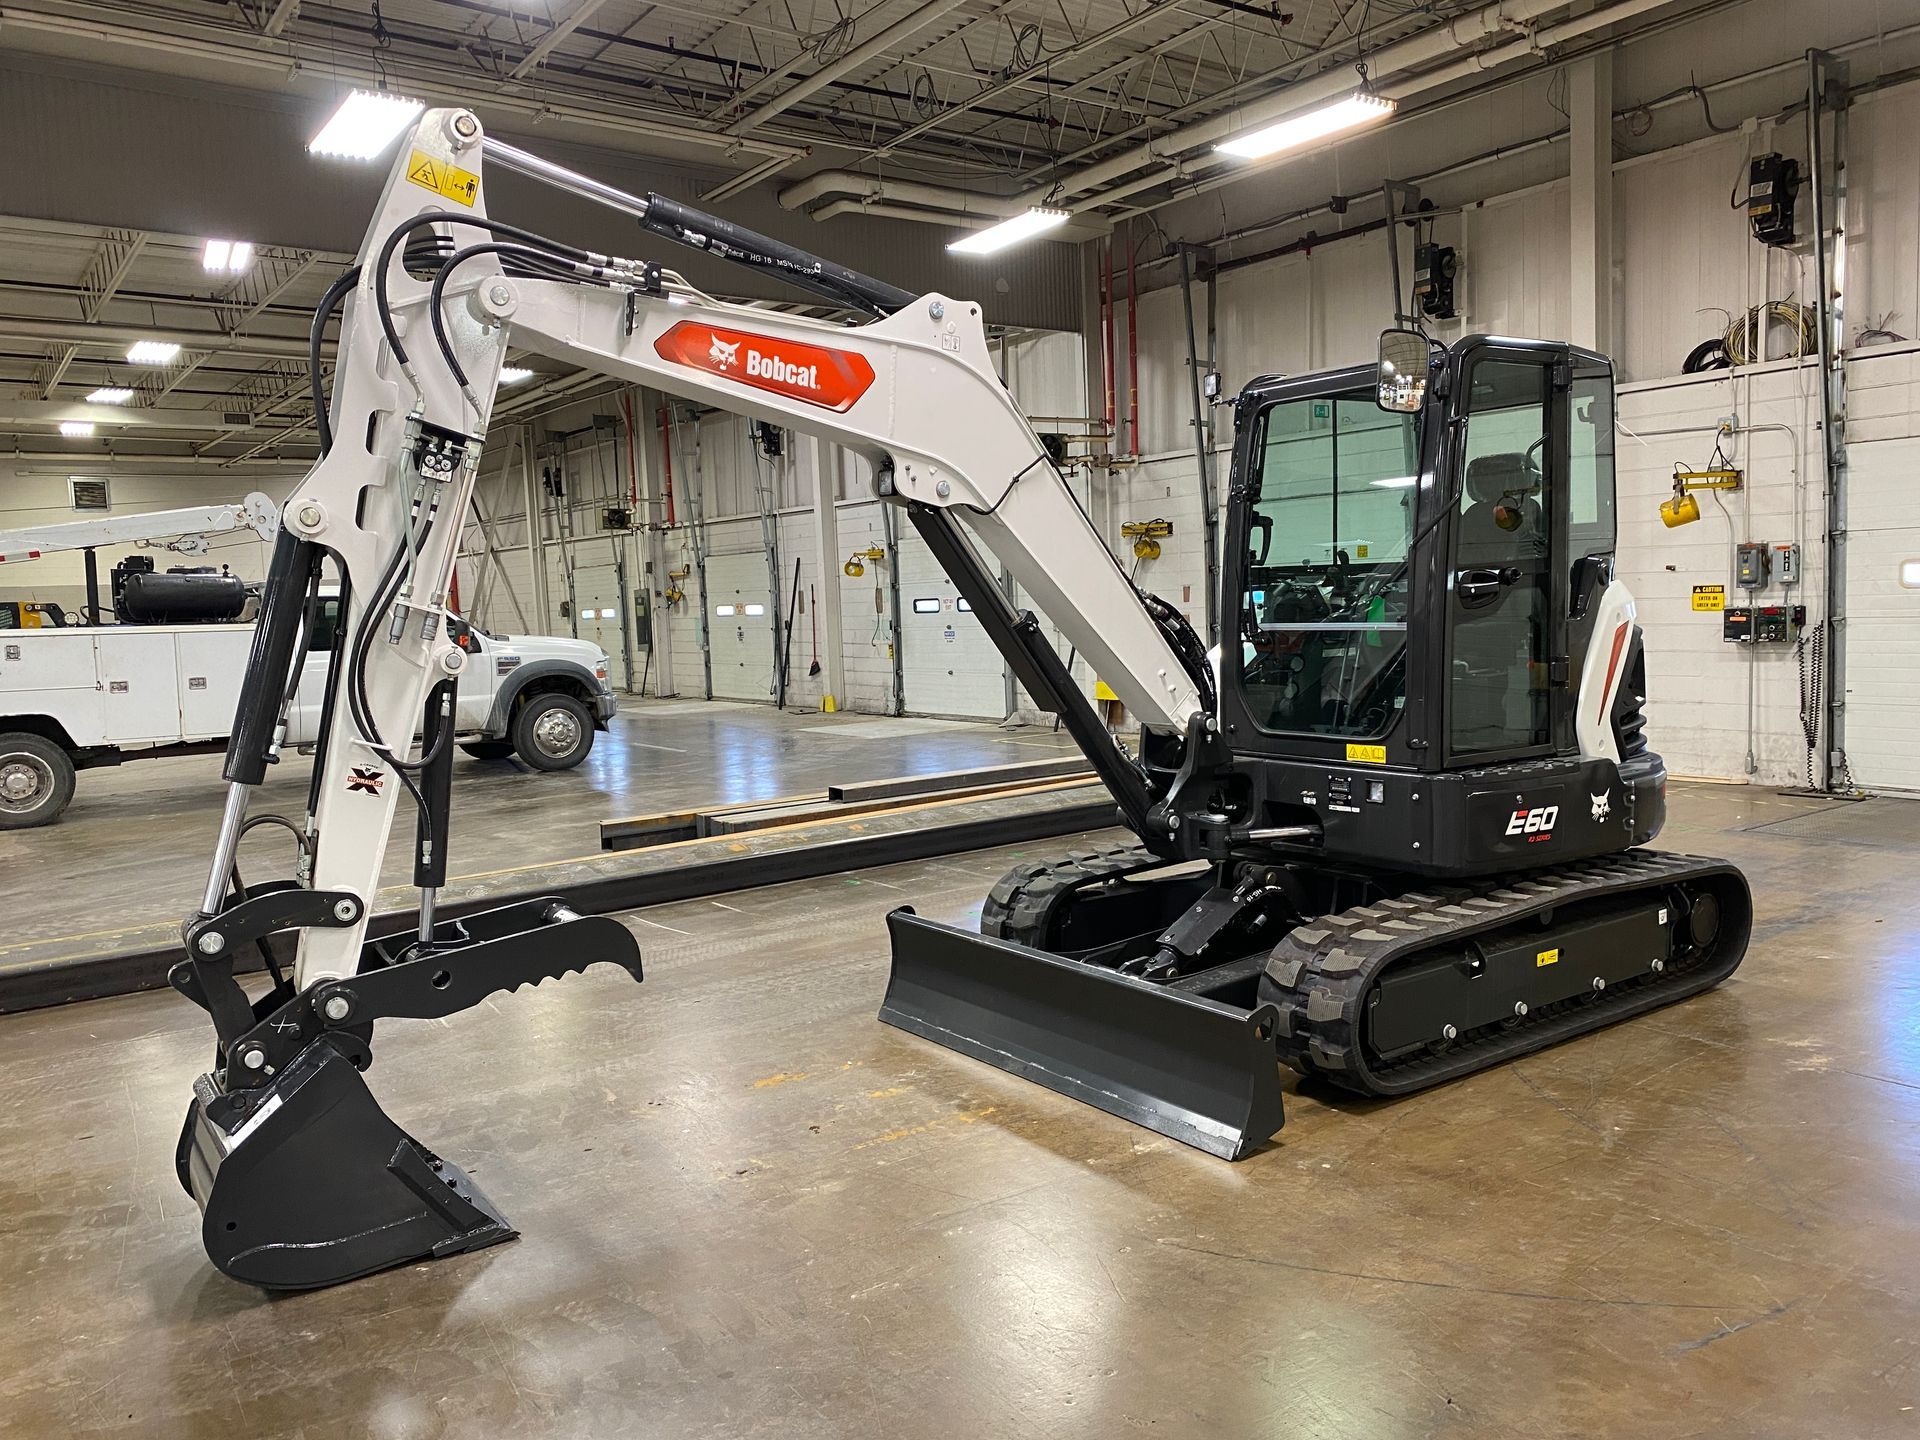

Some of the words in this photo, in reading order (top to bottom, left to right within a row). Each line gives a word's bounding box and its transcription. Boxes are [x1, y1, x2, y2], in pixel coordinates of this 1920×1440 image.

[746, 349, 818, 390] Bobcat
[347, 776, 383, 787] HYDRAULIC
[1505, 805, 1559, 835] E60
